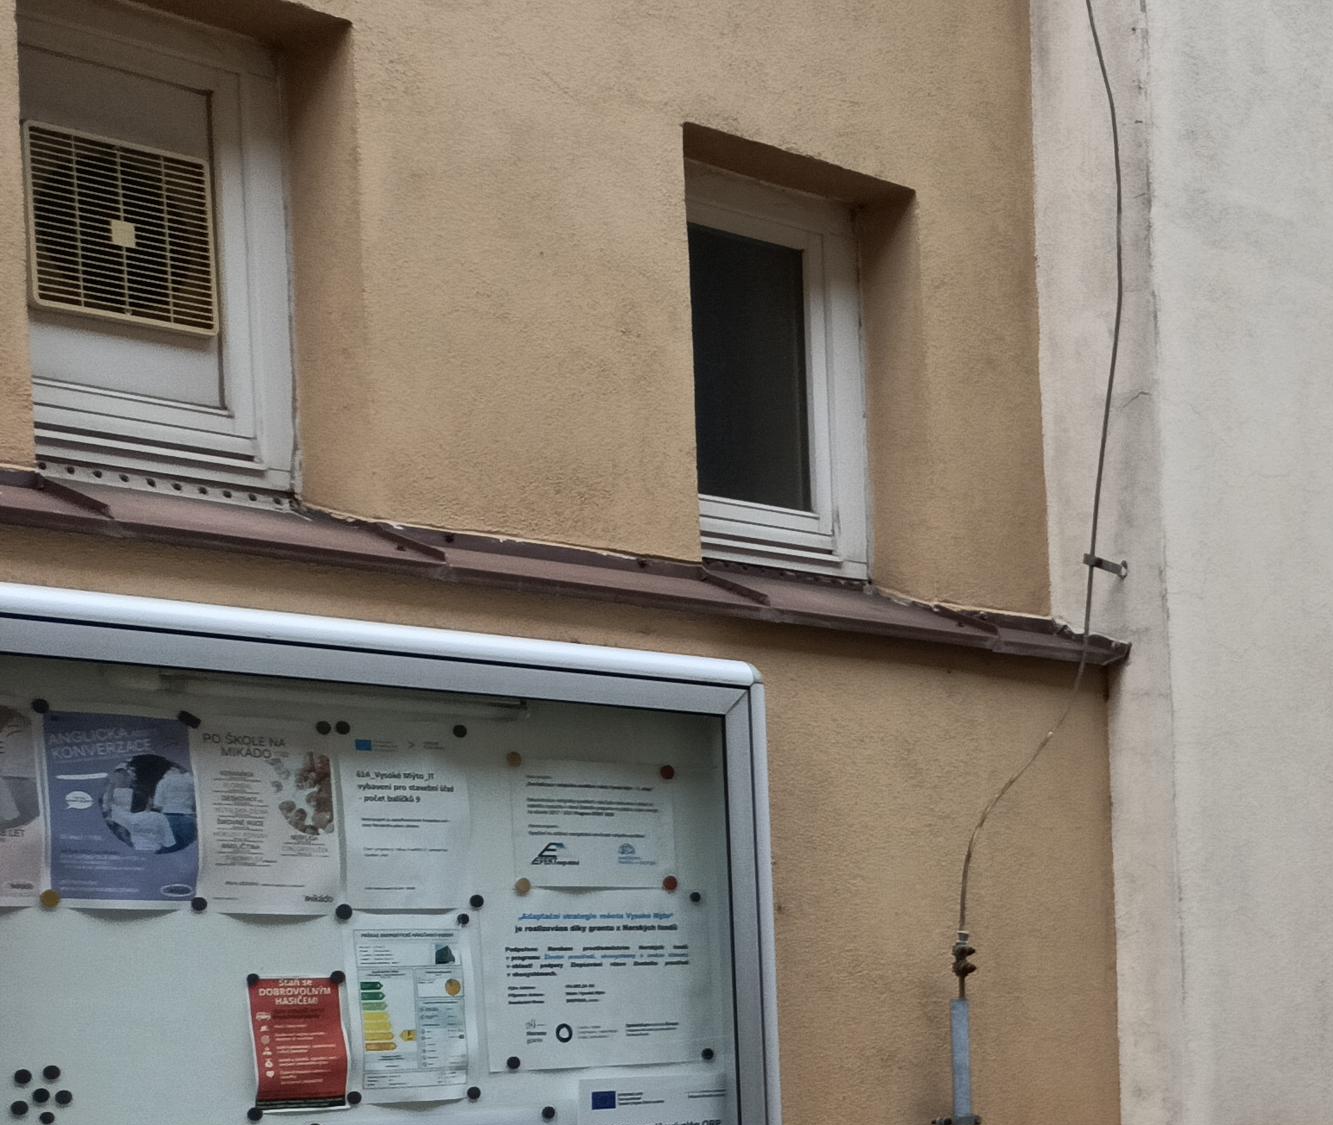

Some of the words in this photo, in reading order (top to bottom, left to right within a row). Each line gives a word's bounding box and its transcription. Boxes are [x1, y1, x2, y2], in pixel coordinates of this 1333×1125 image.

[202, 732, 221, 744] PO
[225, 731, 265, 747] ŠKOLE
[258, 986, 331, 996] DOBROVOLNÝM
